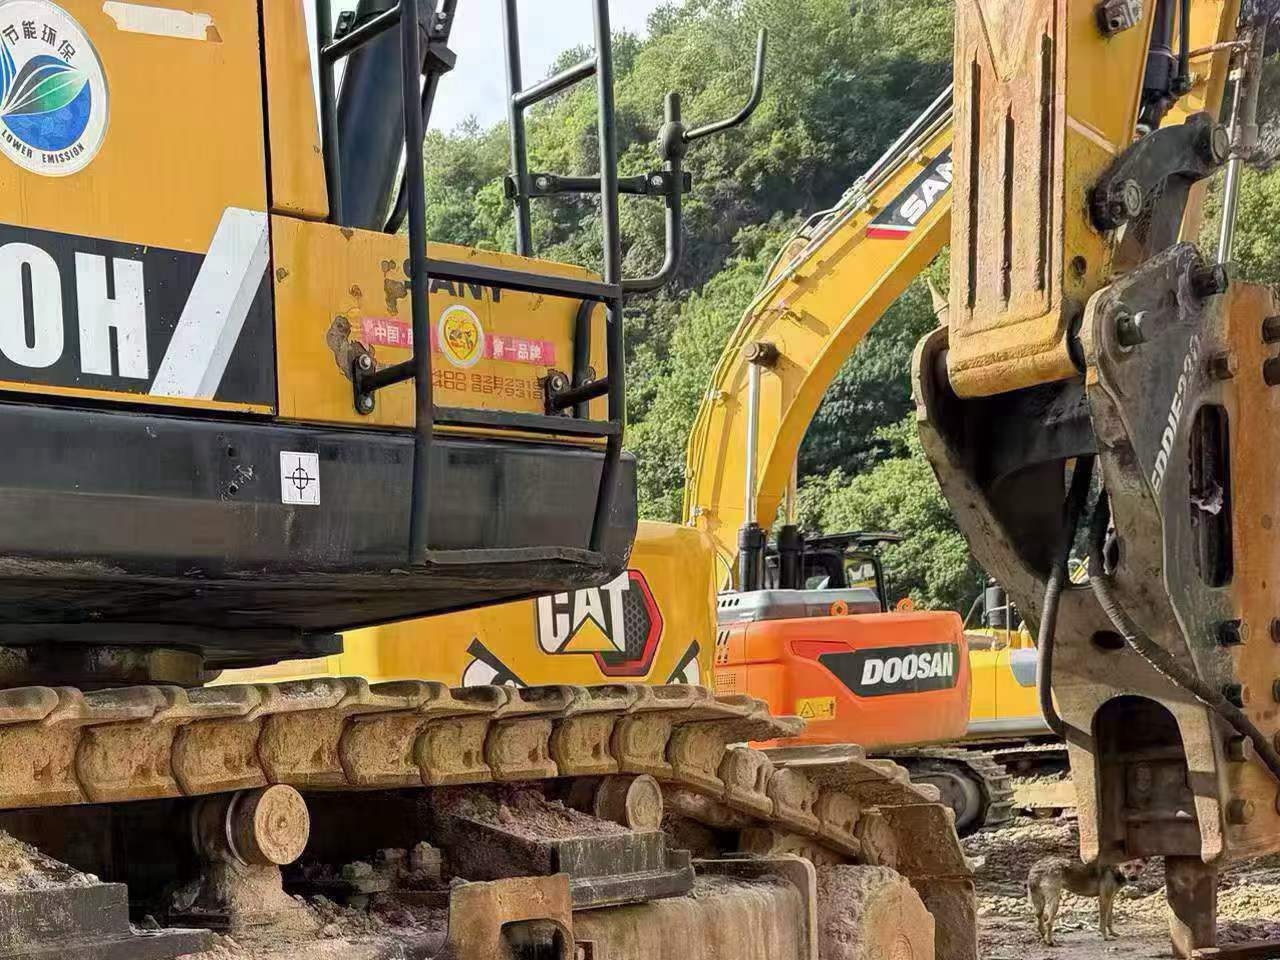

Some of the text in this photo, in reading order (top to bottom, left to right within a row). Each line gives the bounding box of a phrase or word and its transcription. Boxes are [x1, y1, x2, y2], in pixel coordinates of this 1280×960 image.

[2, 19, 76, 63] 节能环保
[1, 129, 85, 164] LOWER EMISSION
[538, 570, 630, 653] CAT
[861, 652, 953, 686] DOOSAN
